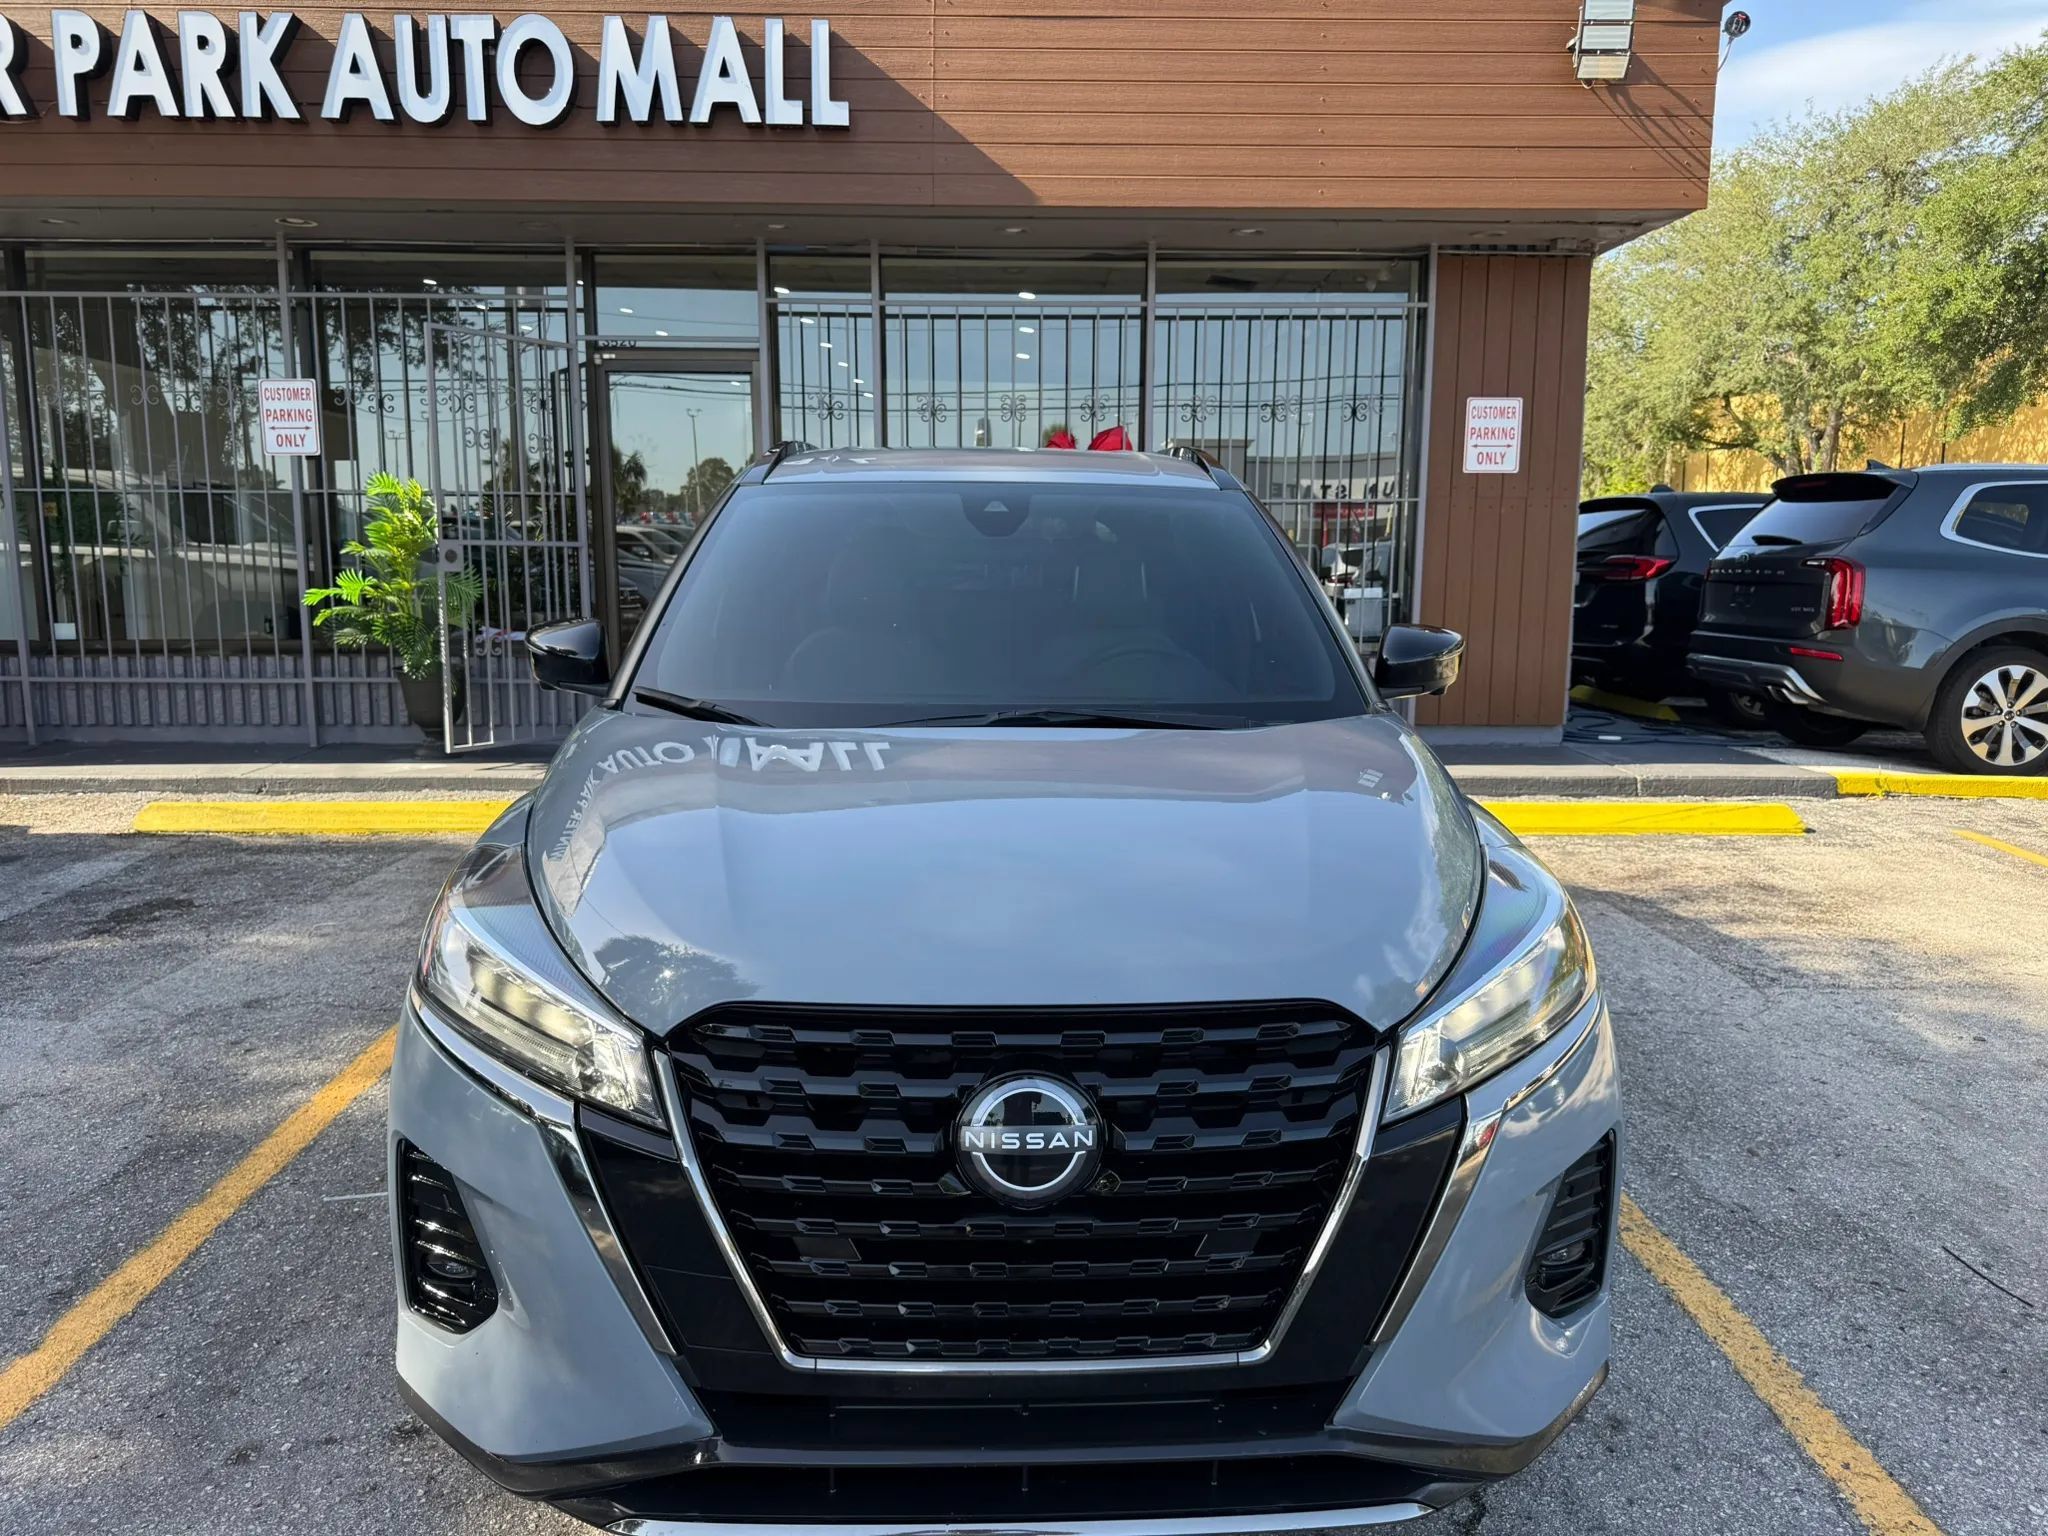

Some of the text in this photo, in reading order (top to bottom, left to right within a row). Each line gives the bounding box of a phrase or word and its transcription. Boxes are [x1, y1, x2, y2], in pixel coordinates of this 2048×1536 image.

[50, 9, 304, 119] PARK
[321, 13, 575, 126] AUTO
[596, 15, 850, 127] MALL
[263, 387, 312, 401] CUSTOMER
[265, 408, 313, 422] PARKING
[1471, 405, 1518, 420] CUSTOMER
[276, 433, 306, 447] ONLY
[1469, 426, 1516, 440] PARKING
[1476, 451, 1507, 465] ONLY
[964, 1129, 1094, 1150] NISSAN
